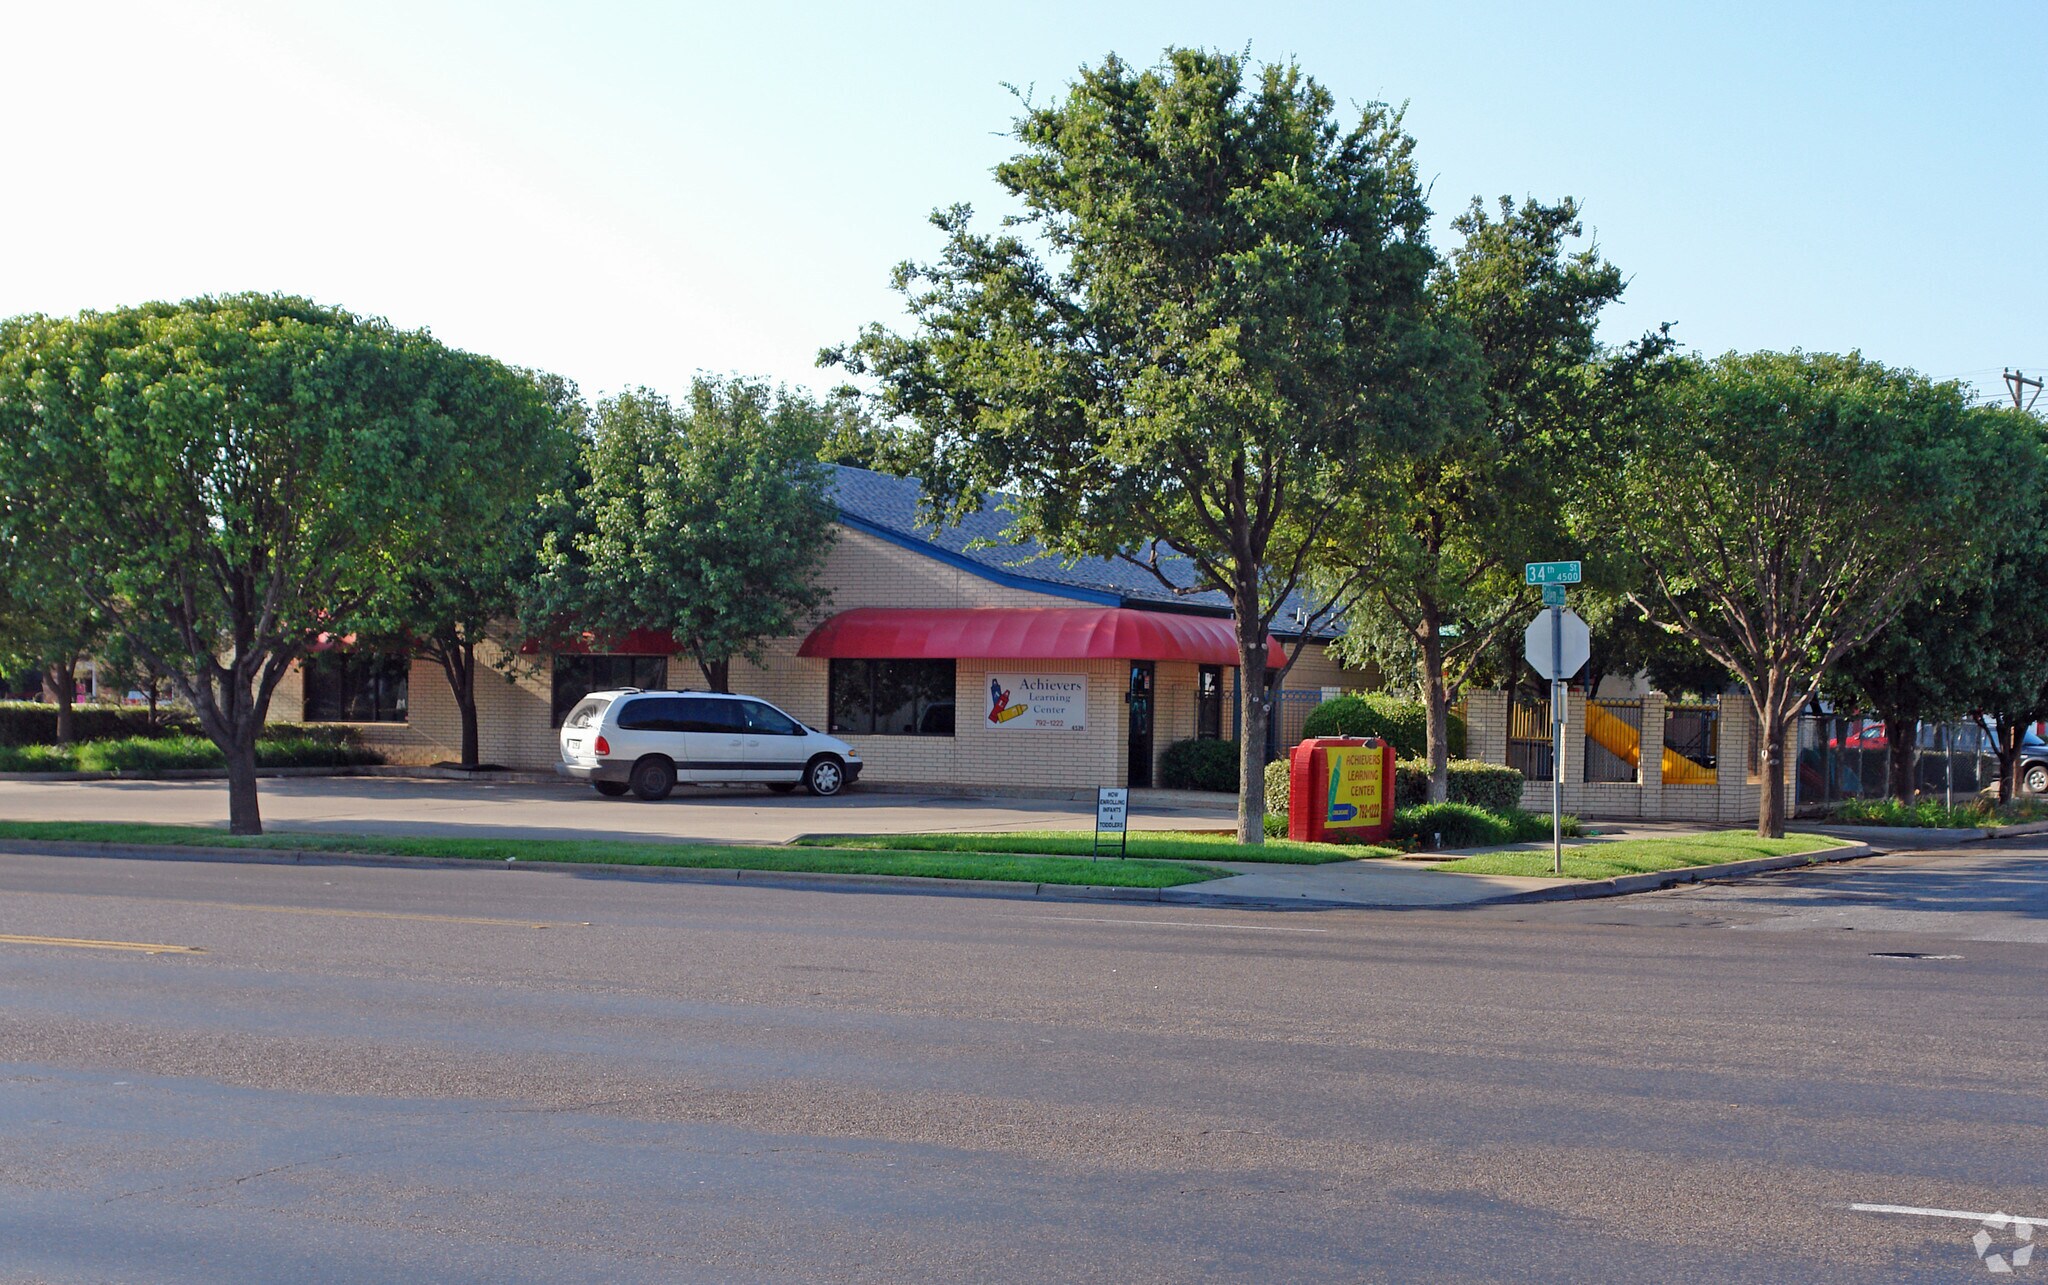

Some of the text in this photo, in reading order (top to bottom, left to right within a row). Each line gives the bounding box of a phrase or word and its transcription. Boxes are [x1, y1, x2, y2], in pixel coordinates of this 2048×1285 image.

[1529, 563, 1577, 581] 34th St
[1557, 572, 1578, 581] 4500
[1020, 678, 1082, 691] Achievers
[1029, 692, 1071, 703] Learning
[1033, 705, 1065, 714] Center
[1035, 719, 1064, 727] 792-1222
[1346, 754, 1381, 766] ACHIEVERS
[1347, 770, 1378, 781] LEARNING
[1350, 785, 1375, 797] CENTER
